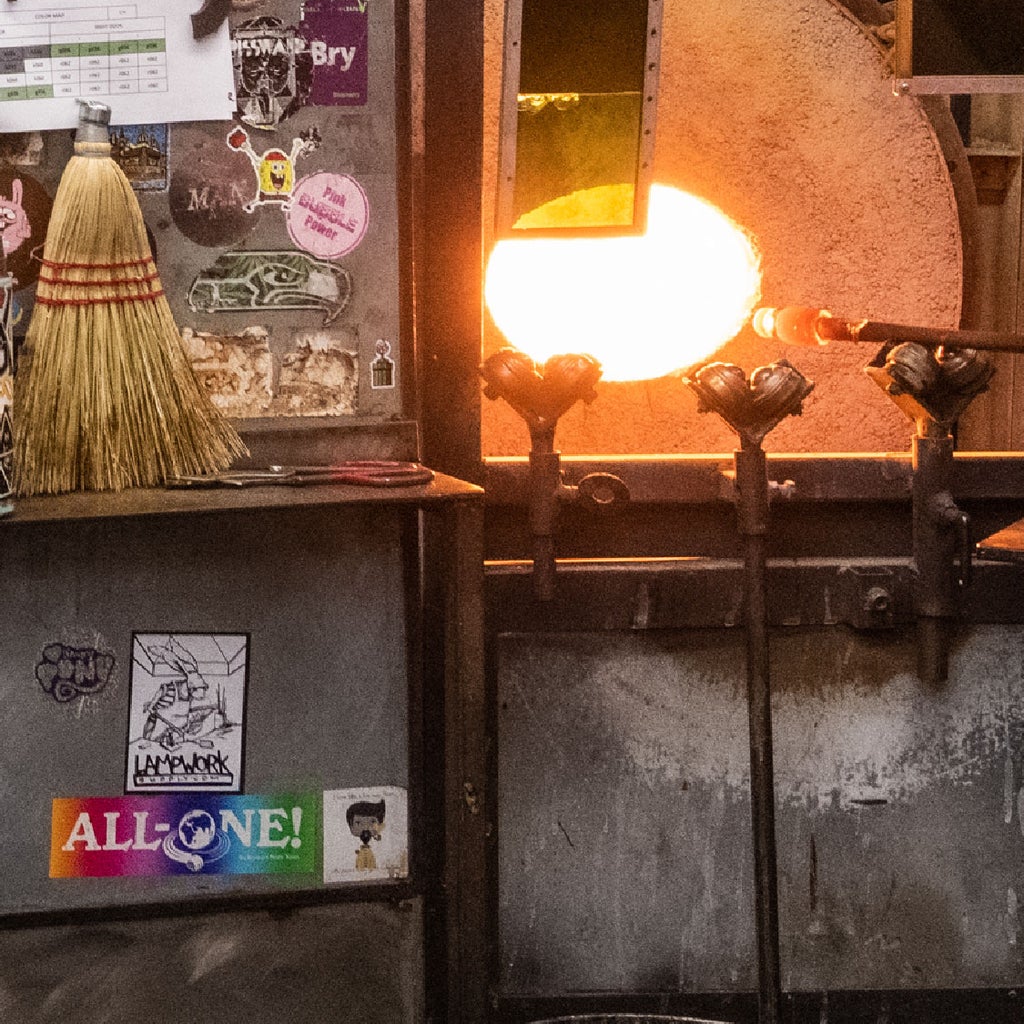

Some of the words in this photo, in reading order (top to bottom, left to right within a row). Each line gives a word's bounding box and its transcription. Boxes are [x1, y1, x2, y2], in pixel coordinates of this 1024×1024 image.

[311, 41, 356, 72] Bry
[323, 185, 347, 207] Pink
[305, 215, 338, 240] Power
[135, 750, 231, 775] LAMPWORK
